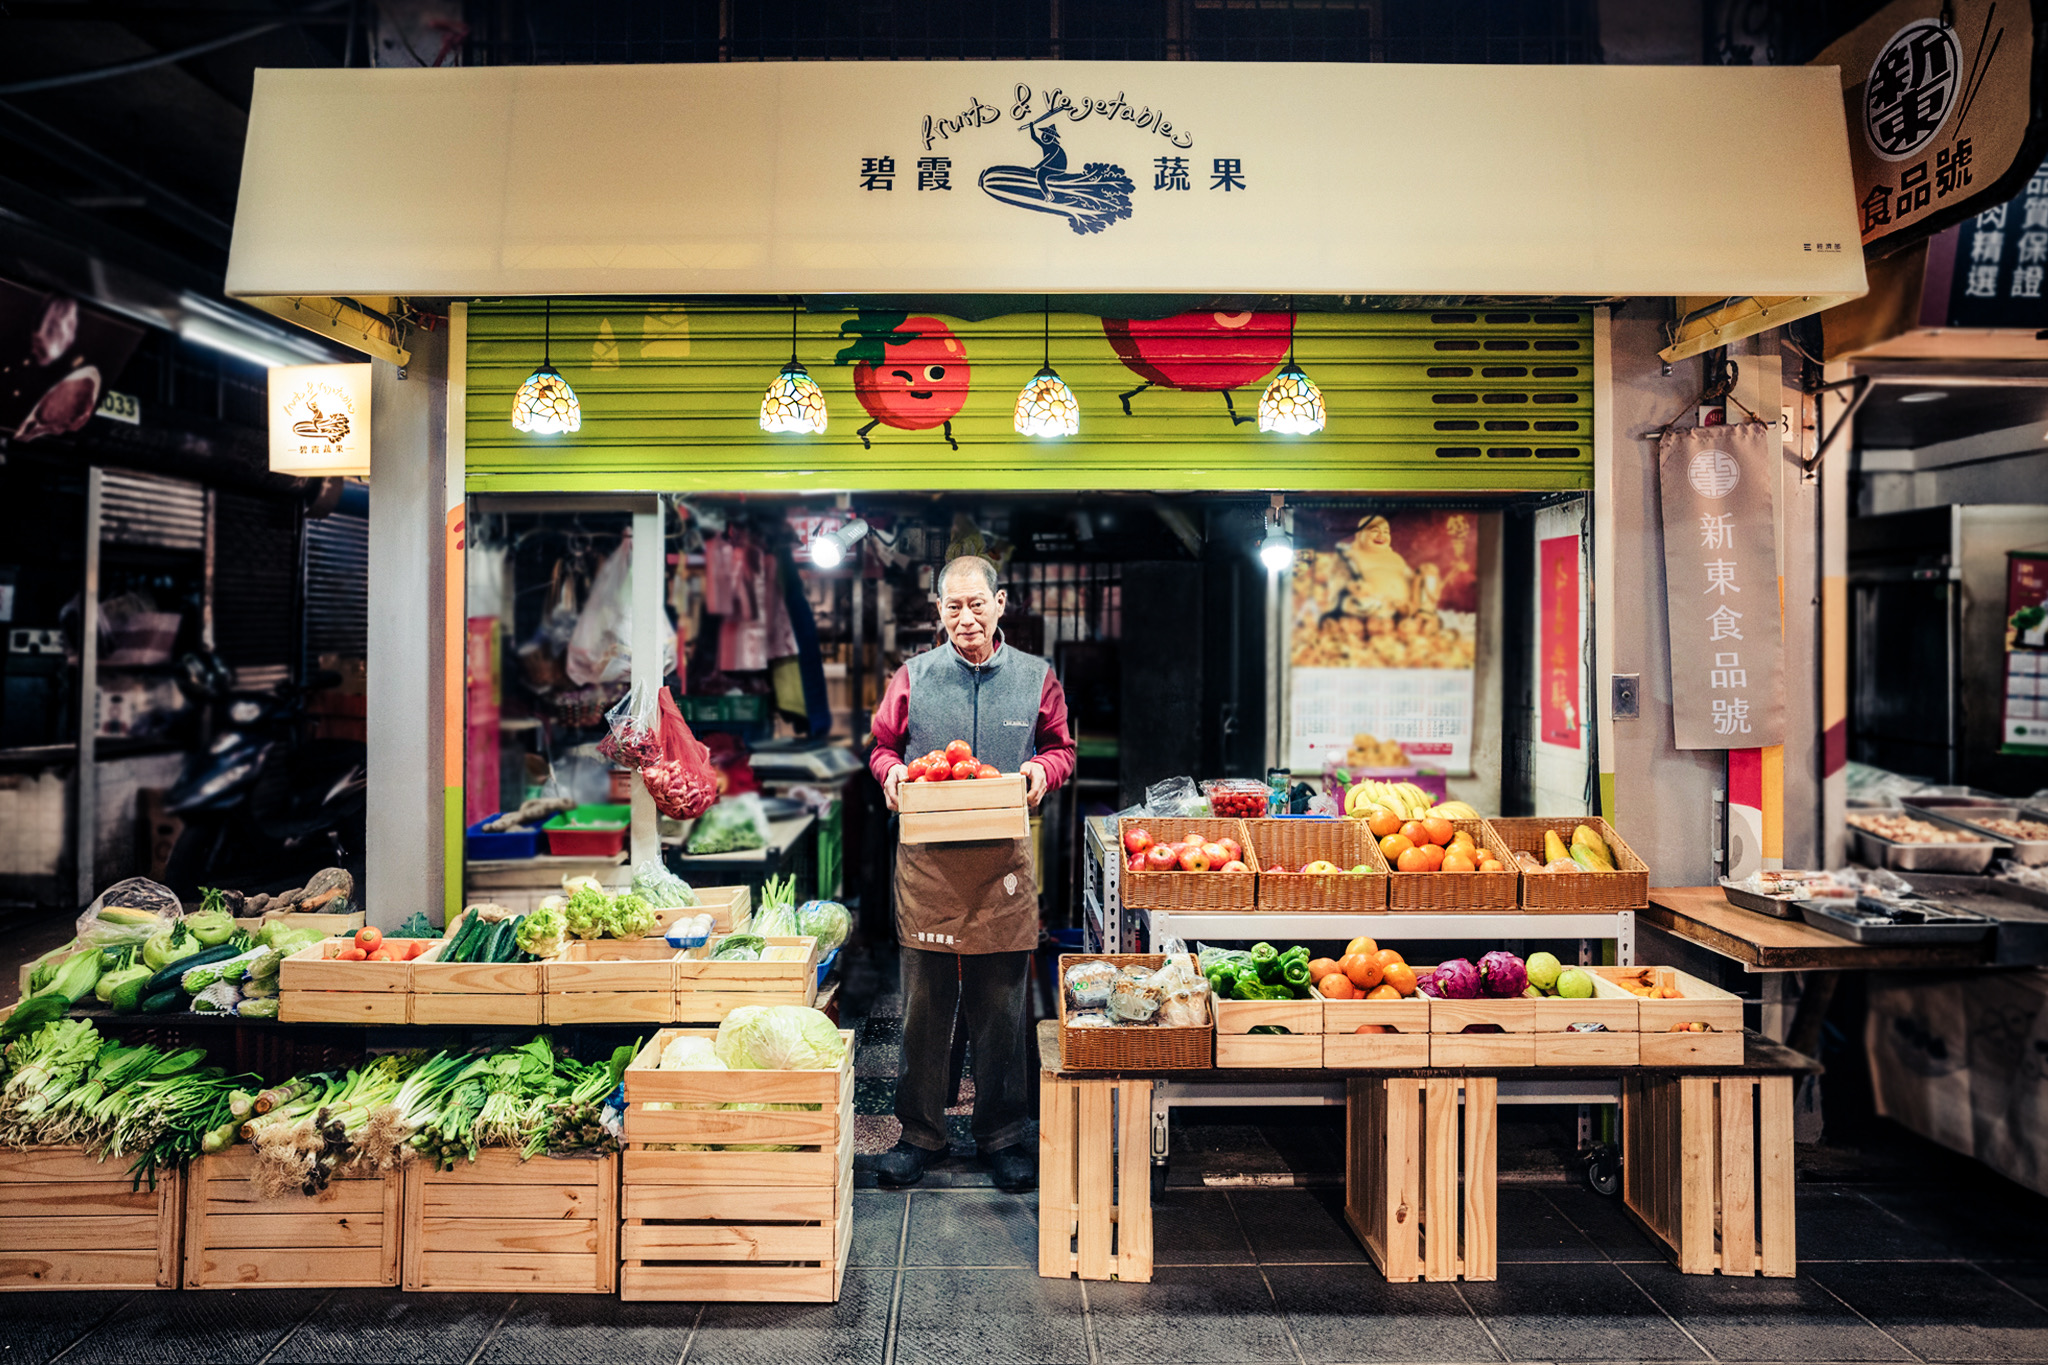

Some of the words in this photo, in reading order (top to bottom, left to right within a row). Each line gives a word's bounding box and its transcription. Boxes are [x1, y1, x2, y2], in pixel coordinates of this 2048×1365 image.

[921, 96, 1001, 151] fruits
[1010, 82, 1032, 121] &
[859, 156, 952, 191] 碧霞
[1153, 156, 1247, 192] 蔬果
[1861, 137, 1973, 236] 食品號
[1699, 511, 1752, 736] 新東食品號
